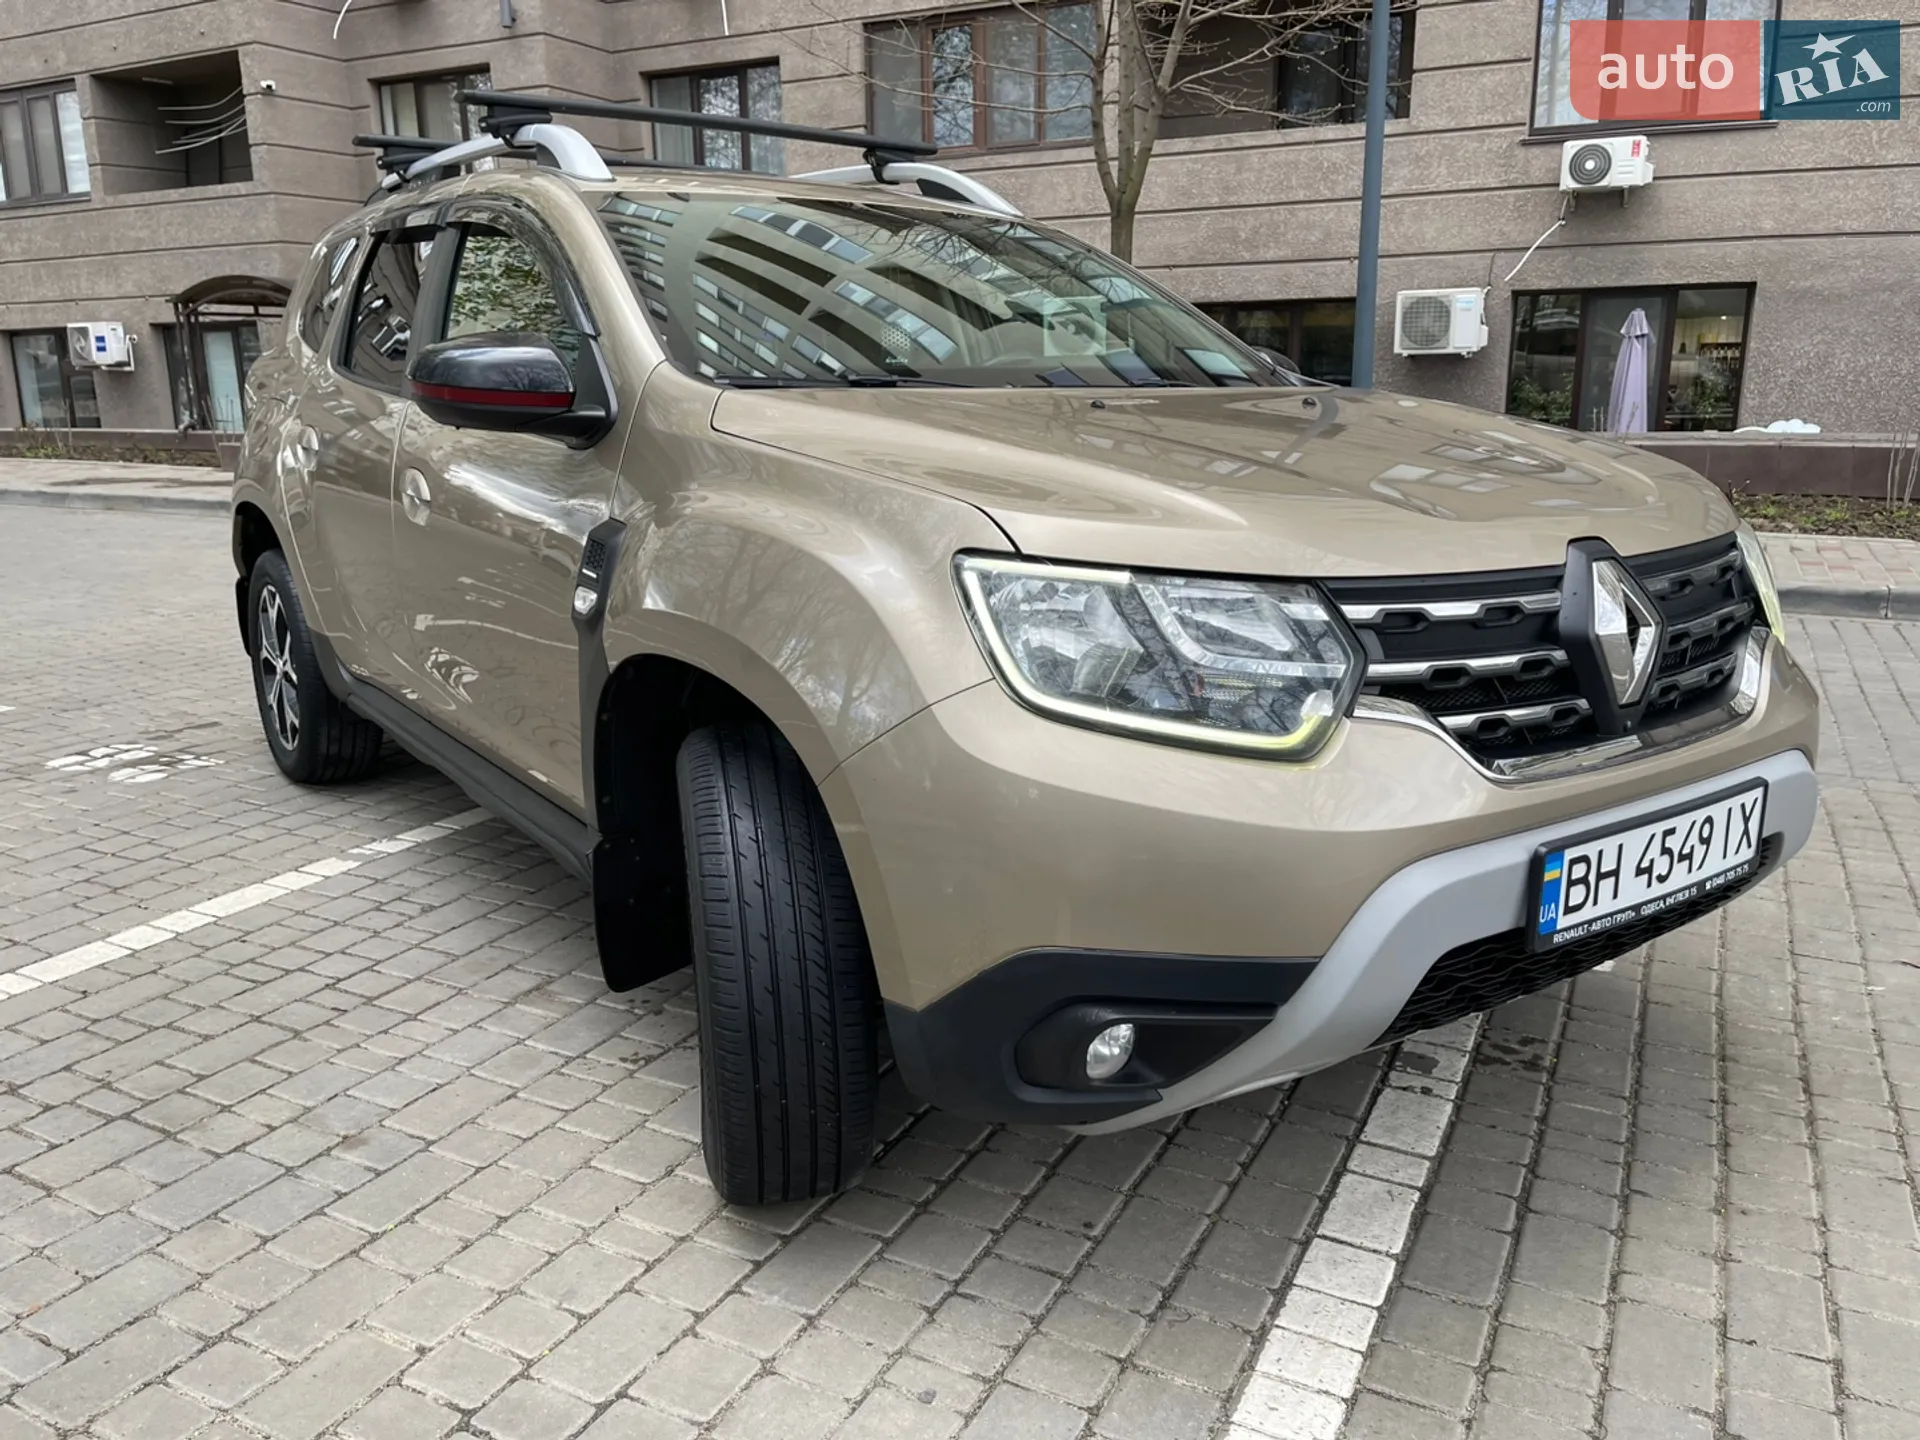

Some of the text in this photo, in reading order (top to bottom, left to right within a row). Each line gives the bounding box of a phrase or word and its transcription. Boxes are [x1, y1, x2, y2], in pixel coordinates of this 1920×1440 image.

[1563, 796, 1759, 917] BH 4549 IX
[1539, 900, 1557, 923] UA
